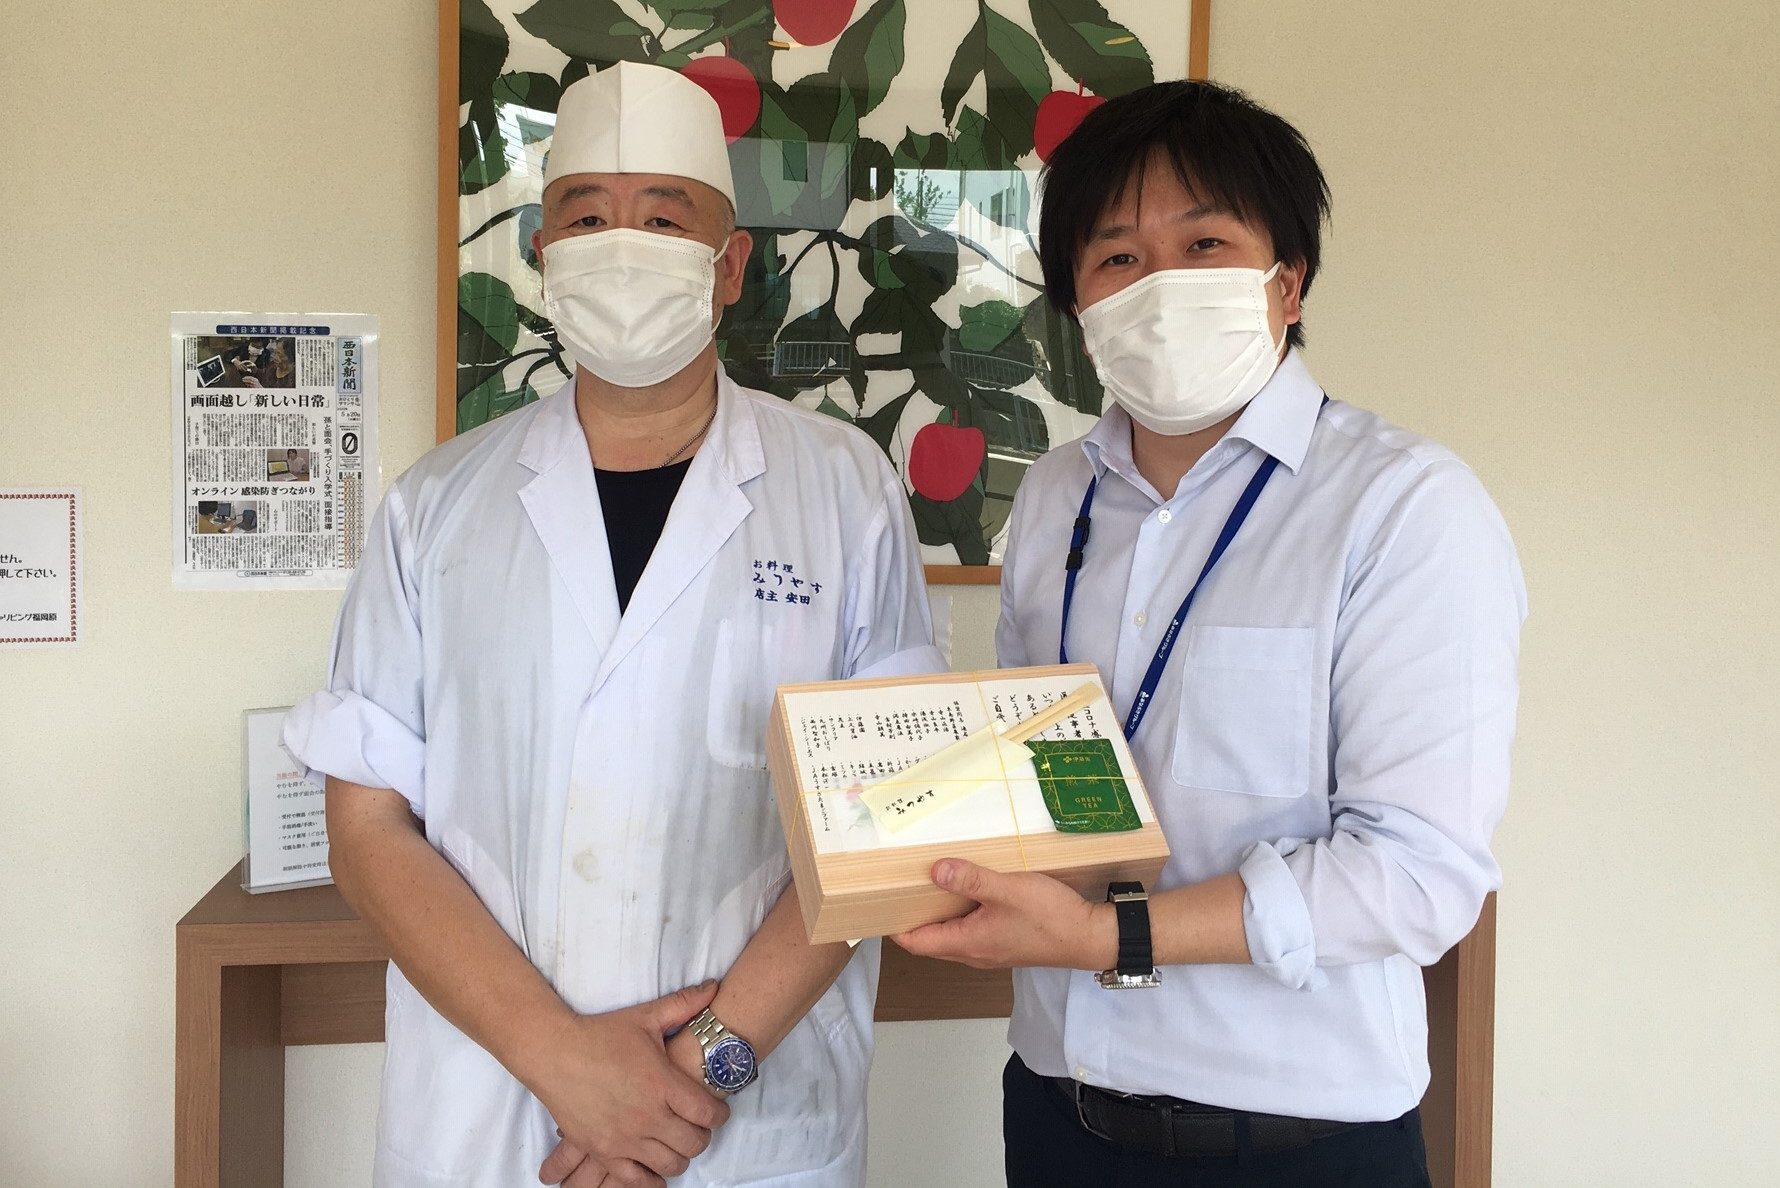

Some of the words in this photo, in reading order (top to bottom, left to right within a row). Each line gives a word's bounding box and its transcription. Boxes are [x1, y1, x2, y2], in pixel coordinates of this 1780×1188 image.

[230, 326, 318, 334] 西日本新聞掲載記念
[342, 341, 357, 390] 西日本新聞
[191, 394, 330, 408] 画面越し「新しい日常」
[192, 487, 238, 496] オンライン
[241, 486, 316, 496] 感染防ぎつながり
[0, 554, 22, 564] せん。
[753, 560, 793, 573] お料理
[753, 572, 822, 594] みつやす
[754, 588, 778, 601] 店主
[785, 592, 810, 605] 安田
[1010, 694, 1022, 725] どうぞ
